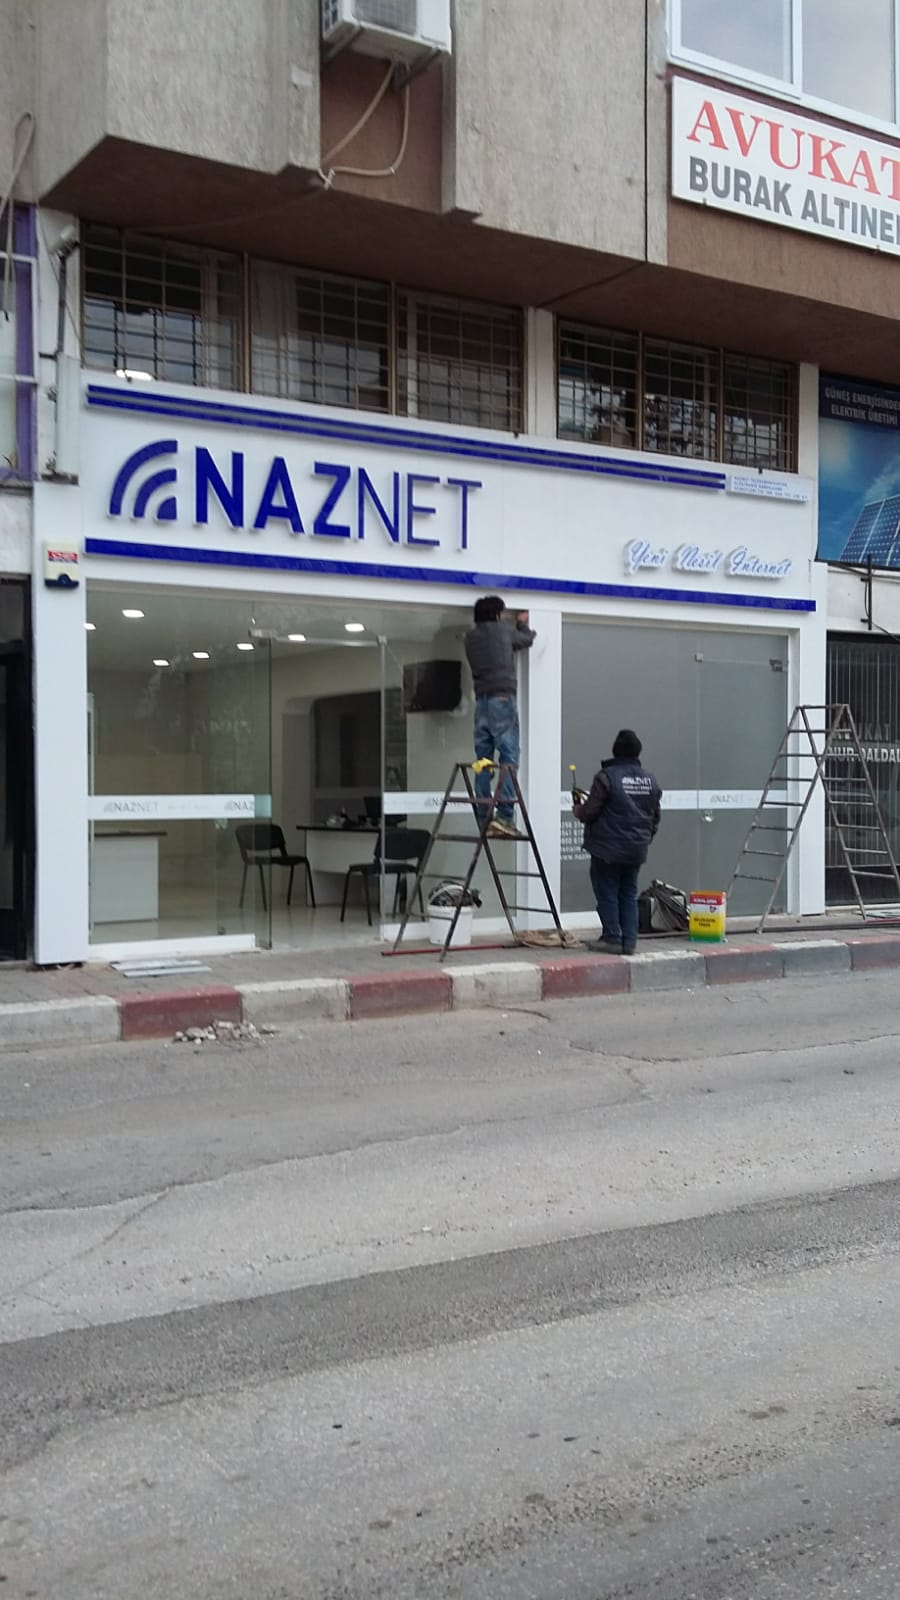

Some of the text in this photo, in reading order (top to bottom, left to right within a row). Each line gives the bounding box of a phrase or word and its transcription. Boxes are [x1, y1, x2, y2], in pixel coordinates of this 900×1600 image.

[686, 100, 900, 202] AVUKAT
[689, 155, 900, 246] BURAK ALTINE
[195, 446, 483, 551] NAZNET
[628, 541, 669, 571] Yeni
[679, 545, 724, 569] Nesil
